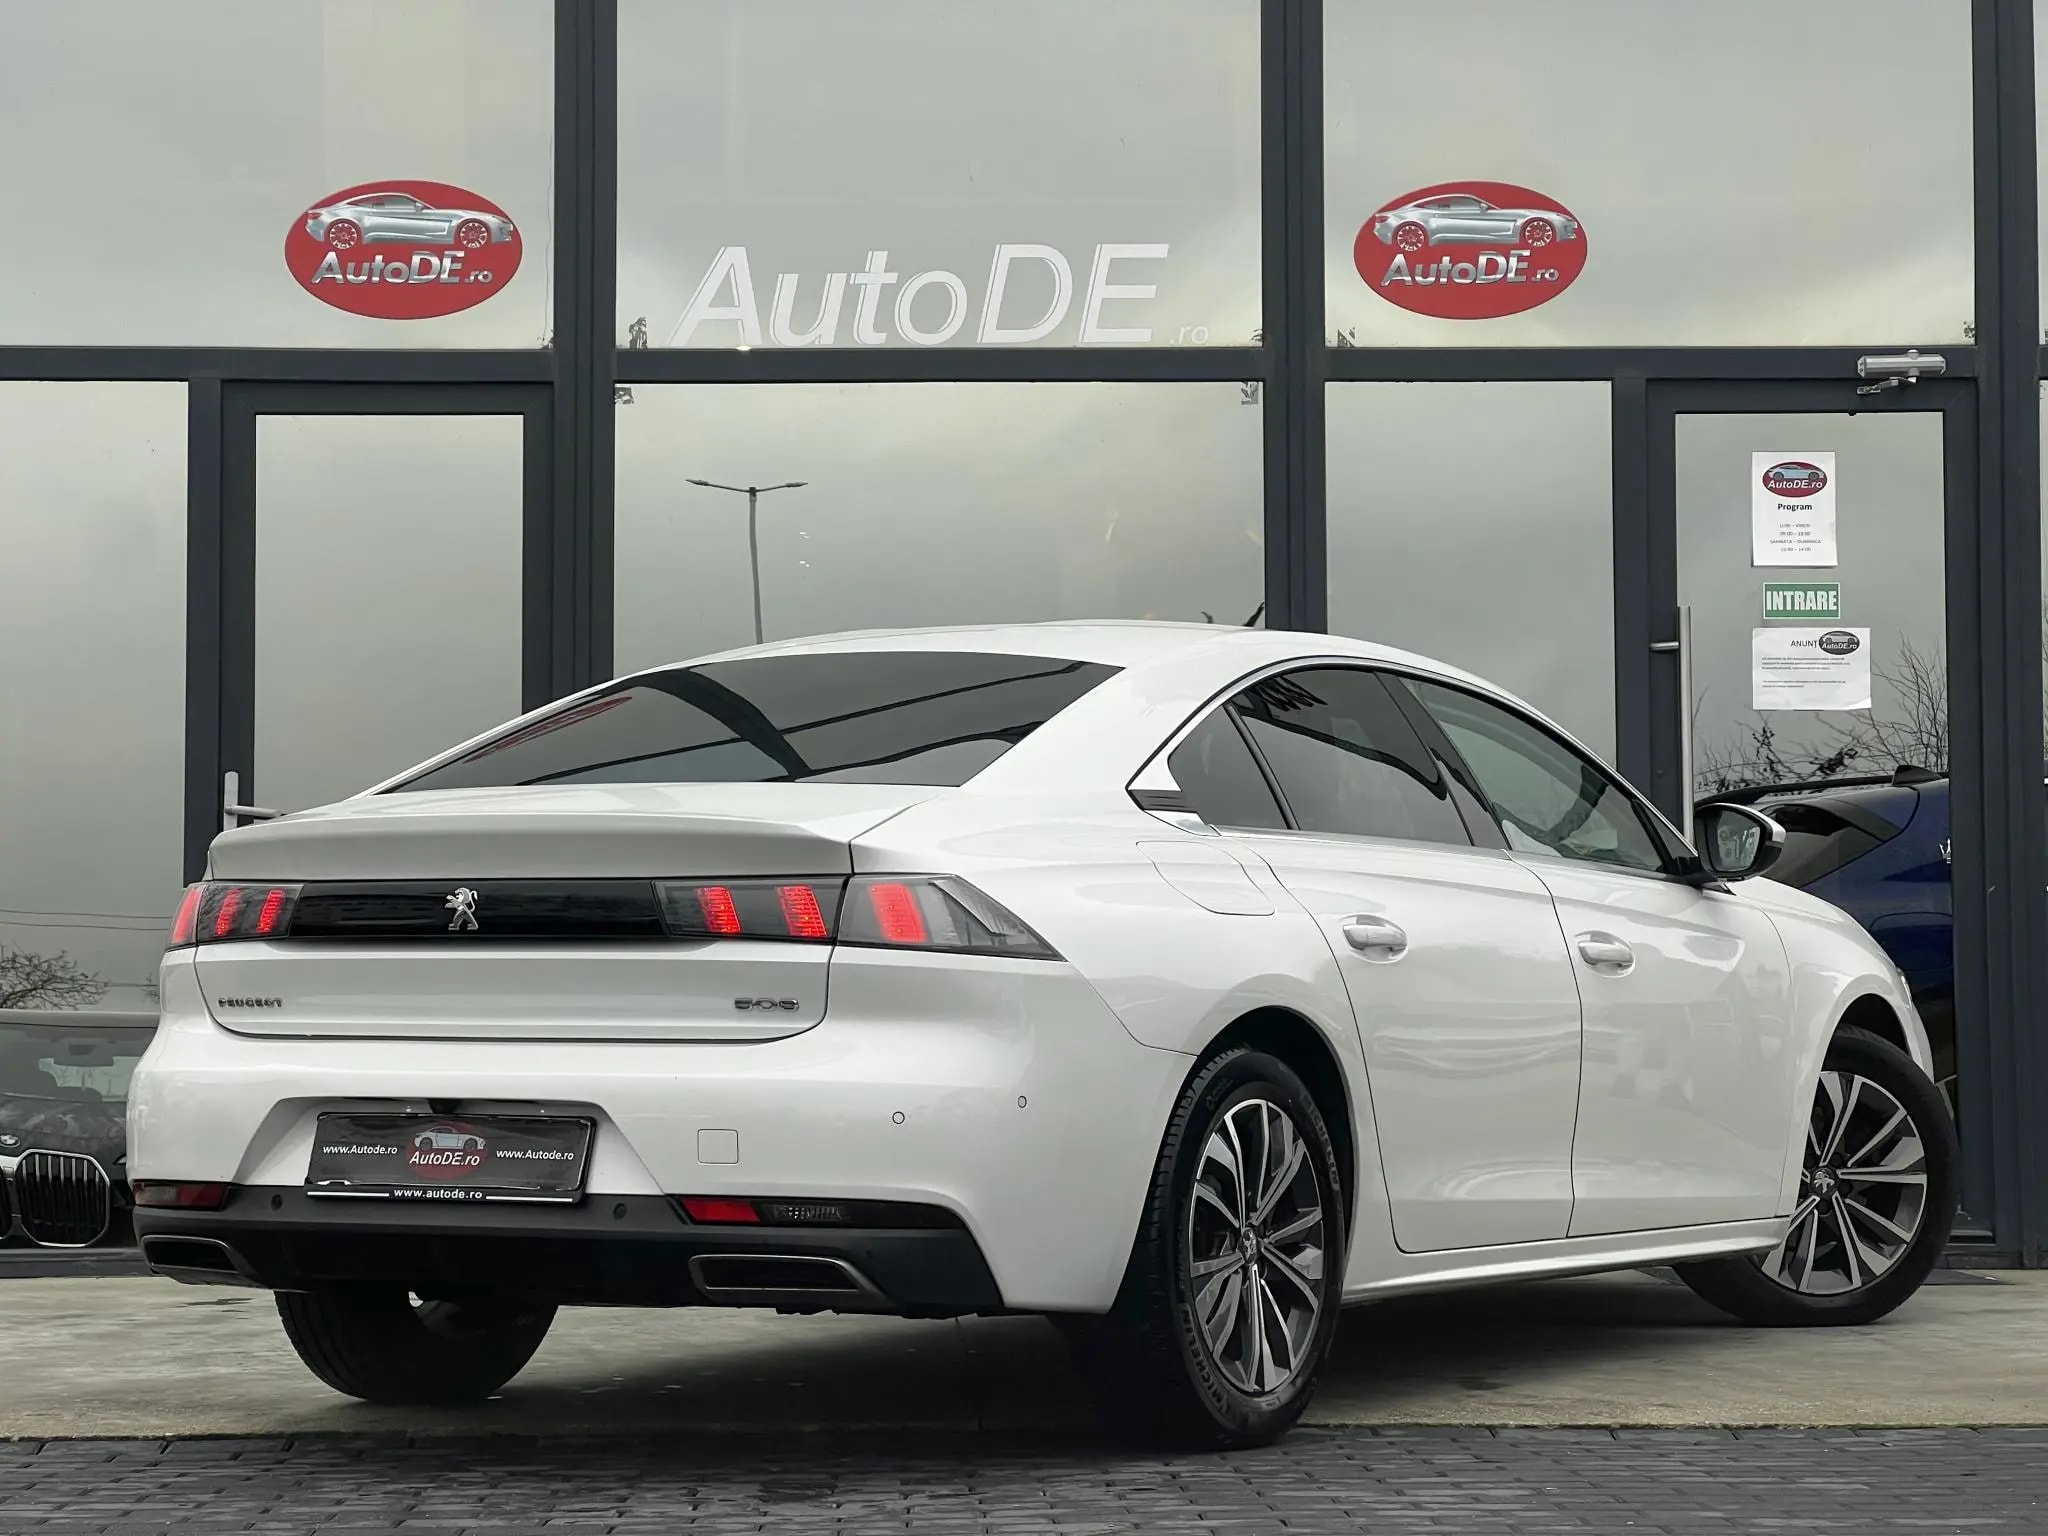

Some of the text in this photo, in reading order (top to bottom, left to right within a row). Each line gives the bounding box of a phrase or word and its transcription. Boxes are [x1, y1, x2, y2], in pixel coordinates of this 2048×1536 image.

[1767, 480, 1823, 489] AutoDE.ro
[1777, 503, 1813, 512] Program
[1766, 590, 1838, 611] INTRARE
[218, 997, 282, 1008] PEUGEOT
[734, 997, 799, 1012] 508
[322, 1144, 398, 1156] www.Autode.ro
[496, 1149, 574, 1161] www.Autode.ro
[409, 1151, 480, 1167] AutoDE.ro
[393, 1188, 483, 1200] www.autode.ro
